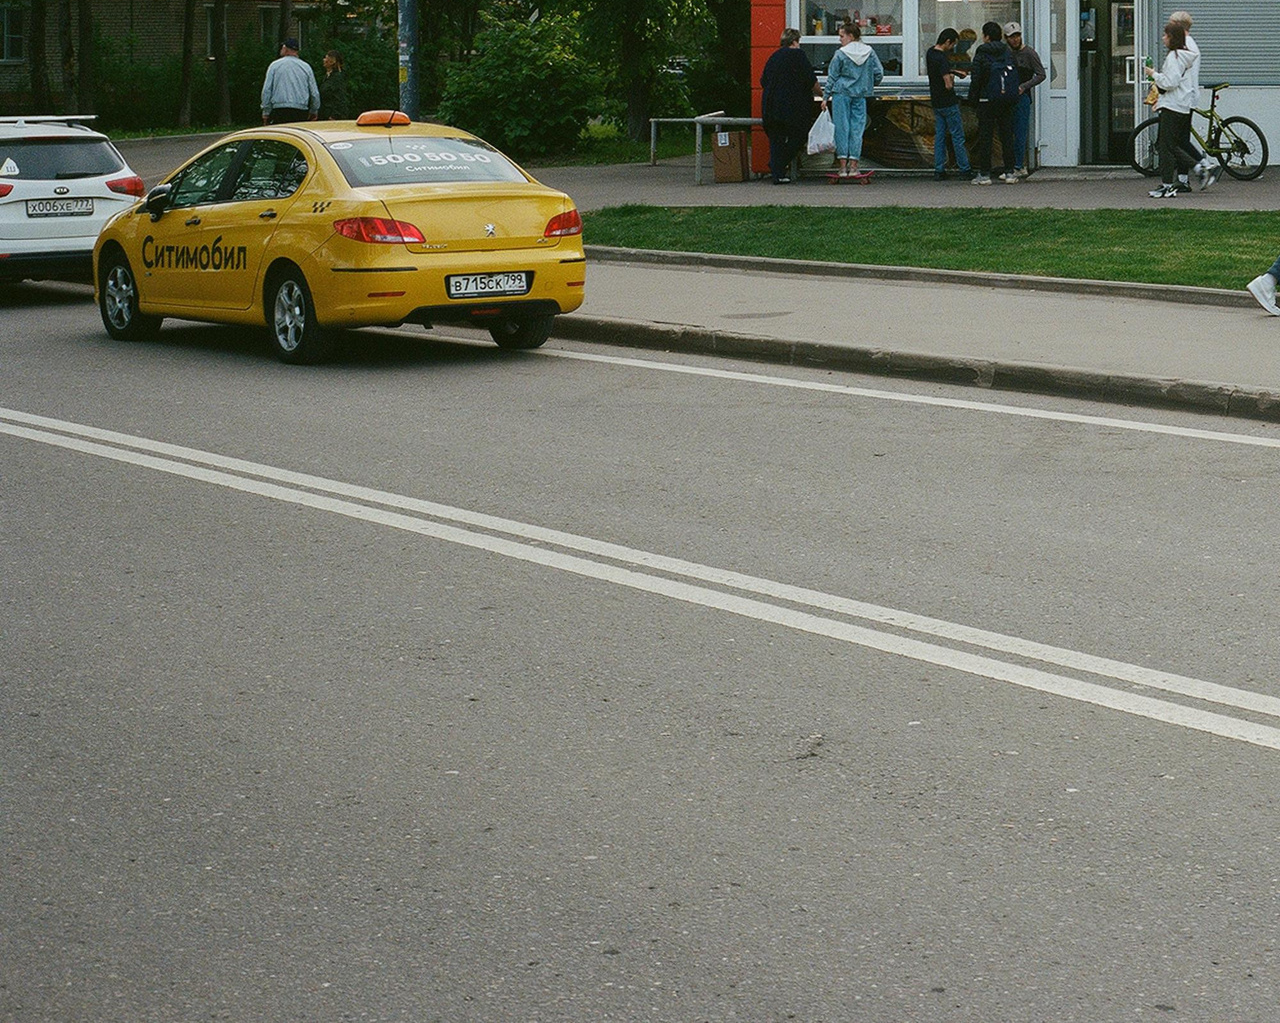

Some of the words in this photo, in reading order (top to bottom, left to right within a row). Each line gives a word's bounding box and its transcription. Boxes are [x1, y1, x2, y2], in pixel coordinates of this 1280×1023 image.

[370, 153, 422, 165] 500
[423, 152, 458, 162] 50
[458, 152, 492, 163] 50
[405, 164, 471, 172] Ситимобил
[142, 235, 247, 271] Ситимобил
[504, 273, 523, 285] 799
